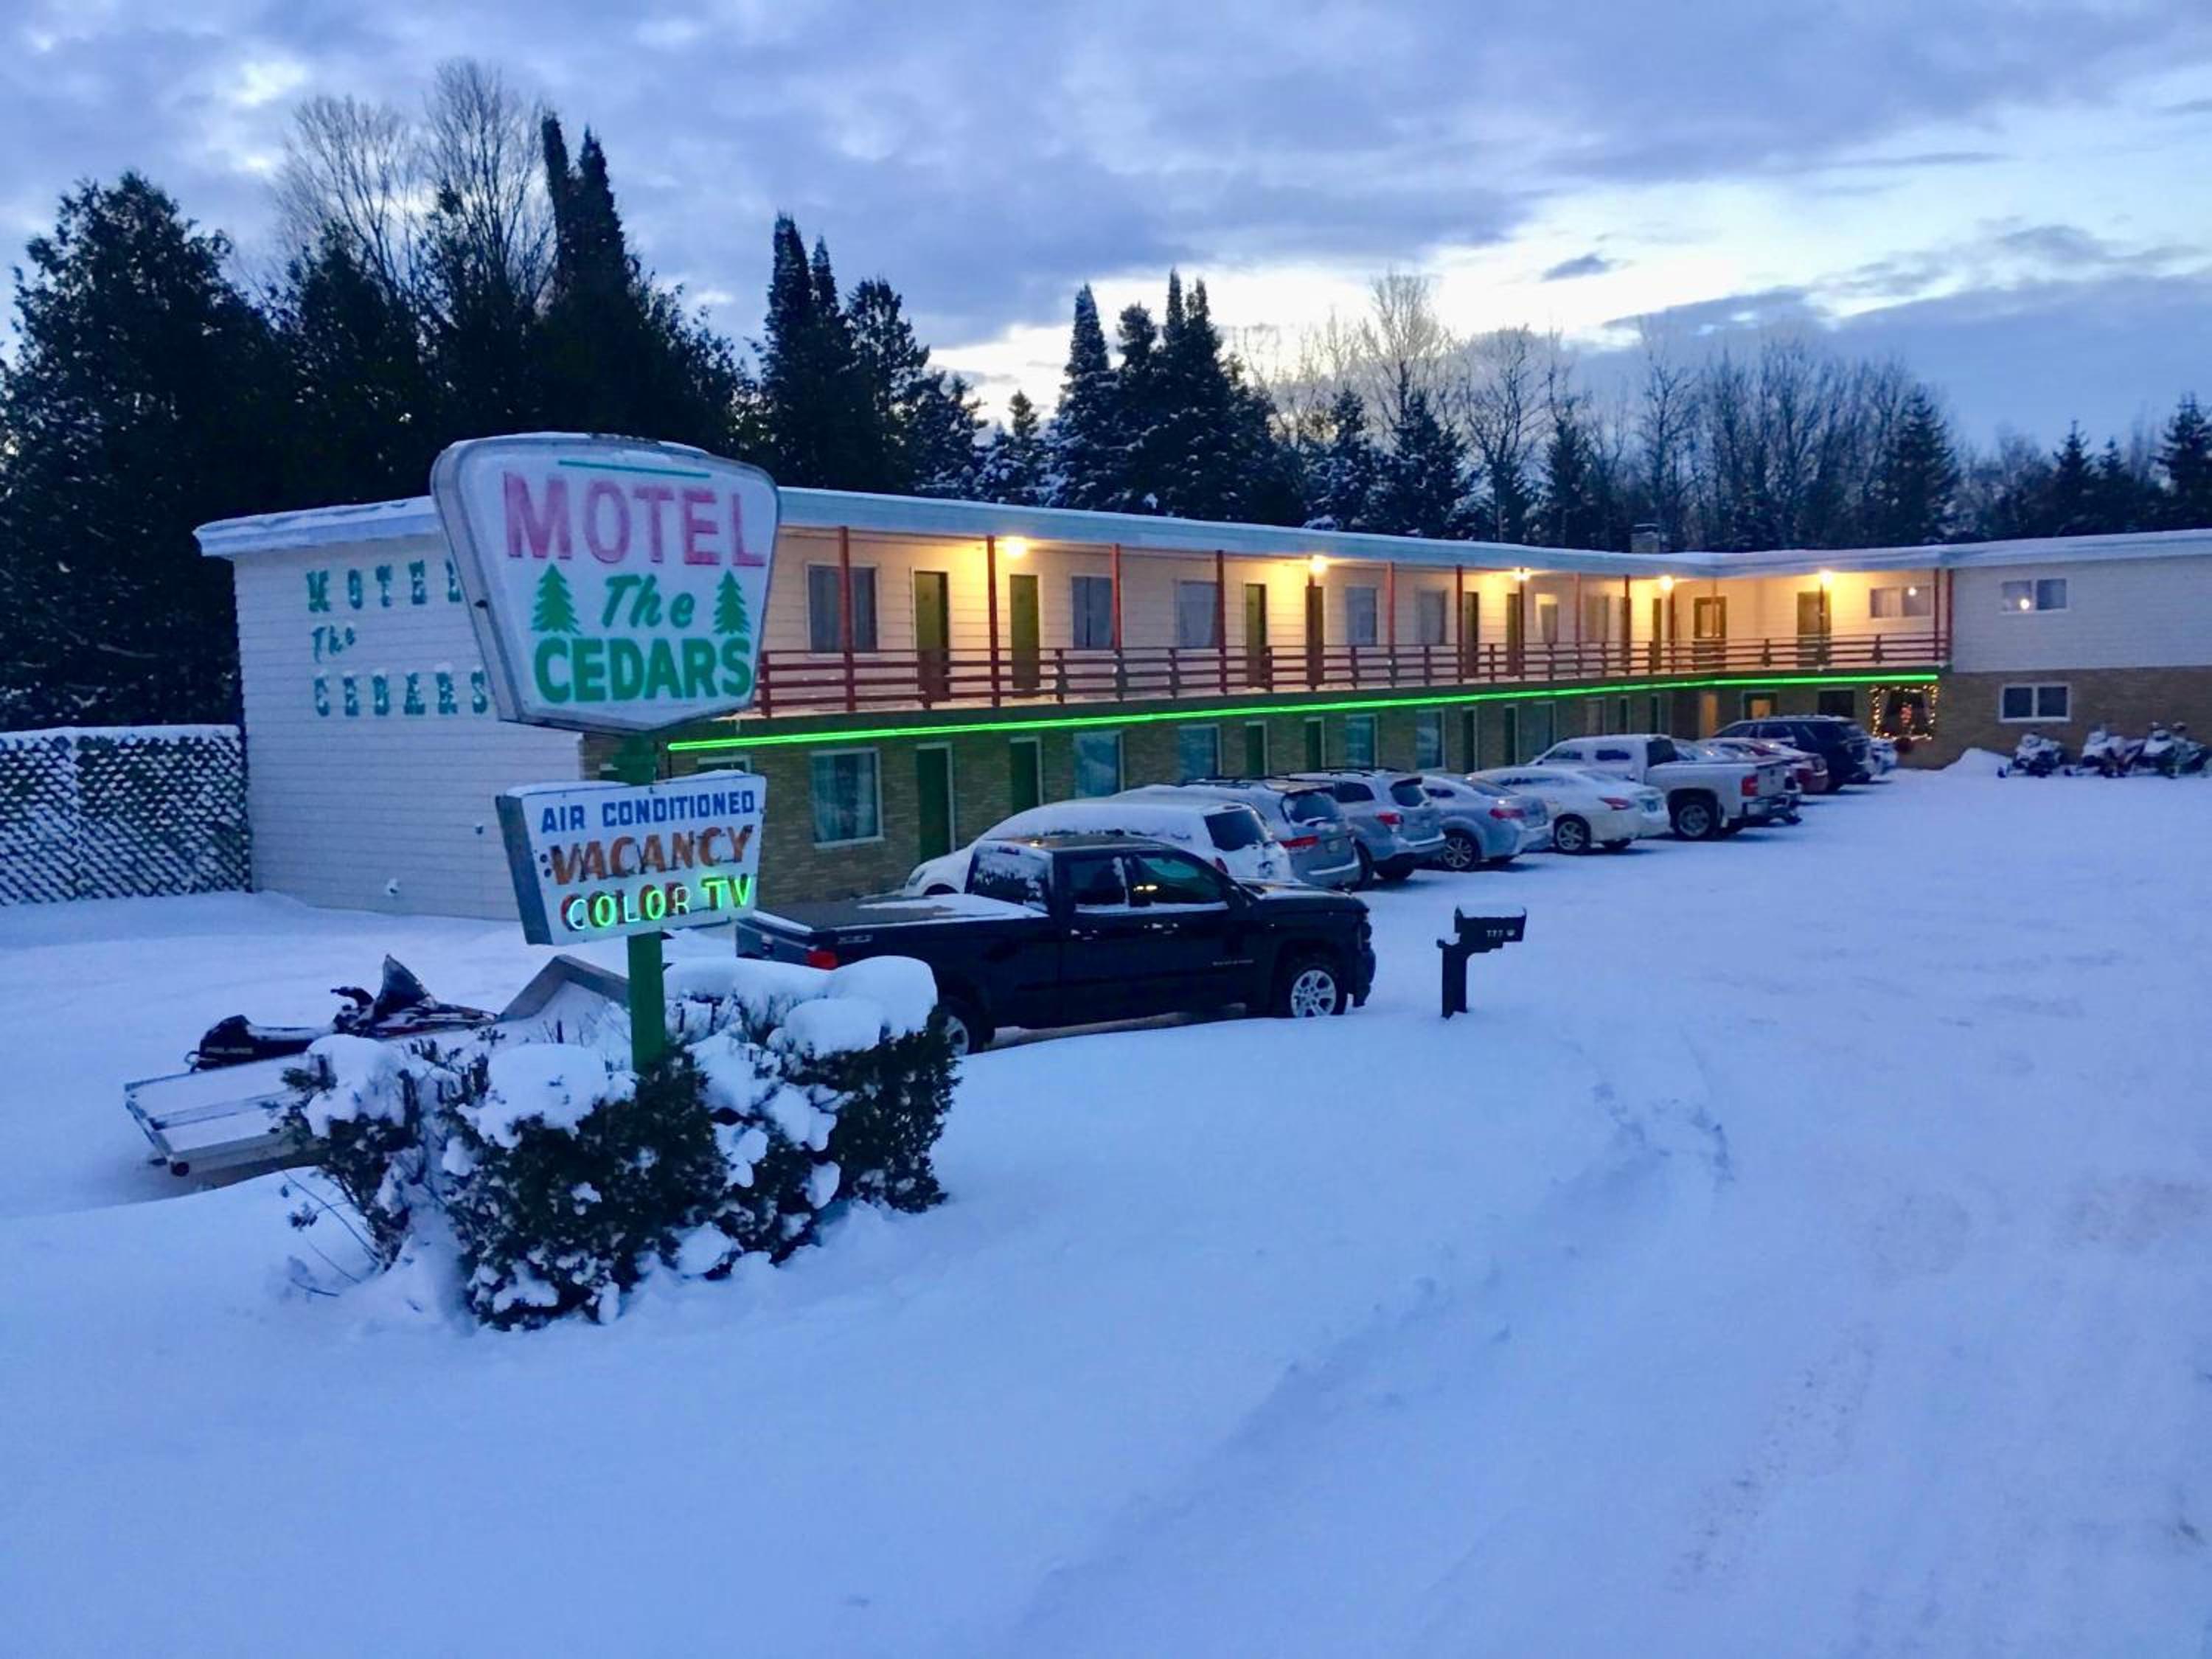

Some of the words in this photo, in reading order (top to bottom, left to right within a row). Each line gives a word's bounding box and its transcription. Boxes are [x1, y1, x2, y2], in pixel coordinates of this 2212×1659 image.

[503, 470, 765, 567] MOTEL
[601, 573, 695, 629] The
[534, 636, 751, 704] CEDARS
[542, 804, 586, 834] AIR
[602, 790, 754, 827] CONDITIONED
[549, 824, 755, 886] VACANCY
[560, 881, 691, 932] COLOR
[701, 873, 751, 912] TV
